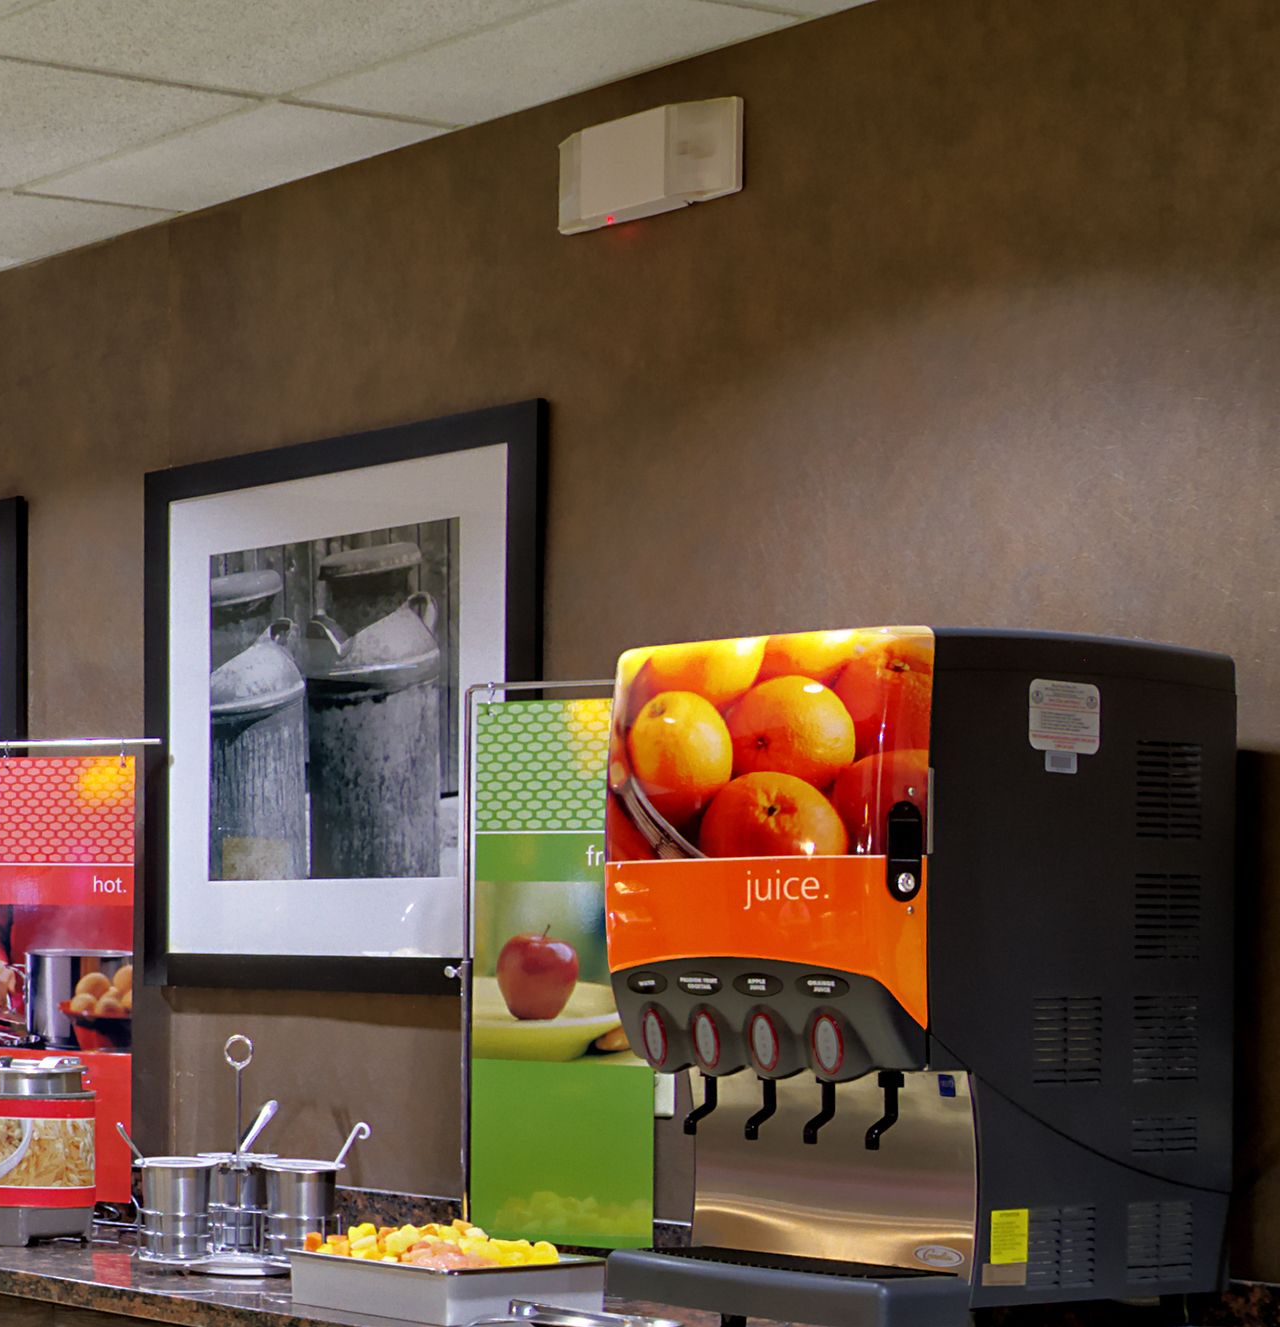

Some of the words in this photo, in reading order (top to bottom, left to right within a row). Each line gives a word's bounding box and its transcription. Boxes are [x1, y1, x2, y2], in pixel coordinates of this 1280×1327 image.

[585, 844, 605, 867] fr
[93, 875, 127, 893] hot.
[744, 869, 829, 909] juice.
